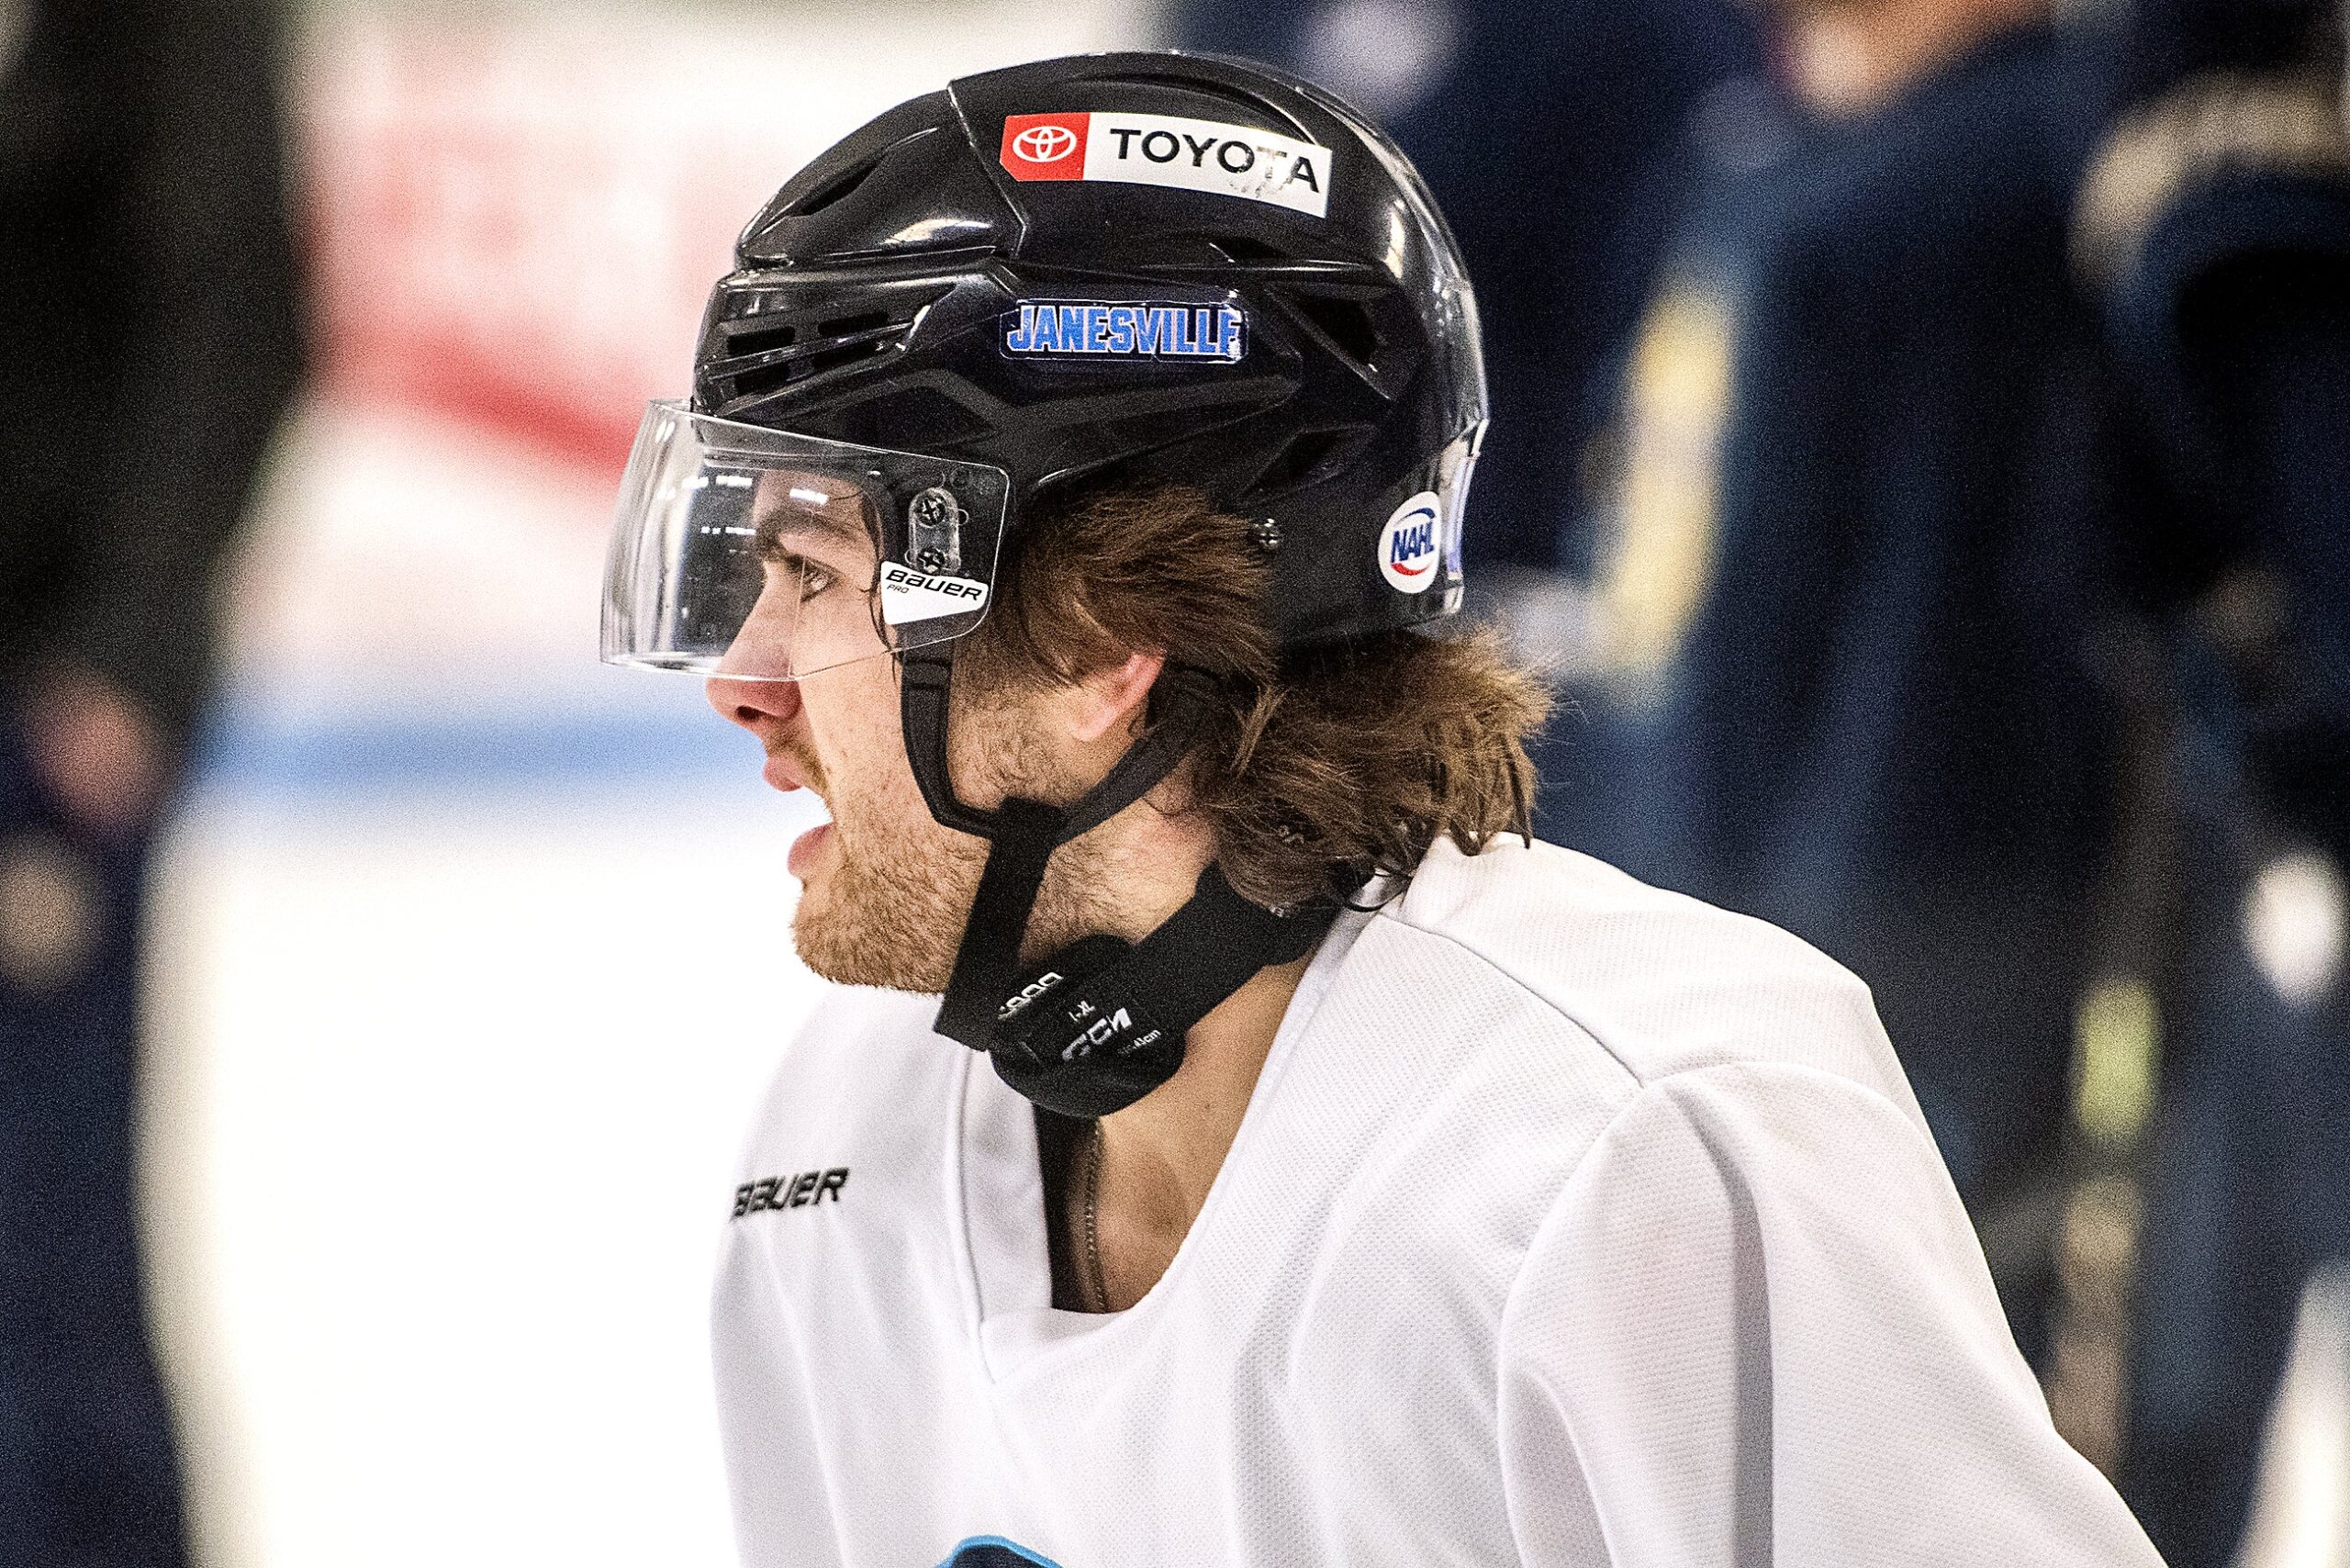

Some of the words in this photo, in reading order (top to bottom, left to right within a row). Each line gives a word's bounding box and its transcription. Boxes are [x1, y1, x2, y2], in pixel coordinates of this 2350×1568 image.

[1109, 128, 1321, 194] TOYOTA
[1006, 304, 1242, 360] JANESVILLE
[1391, 521, 1435, 564] NAHL
[886, 584, 910, 594] PRO
